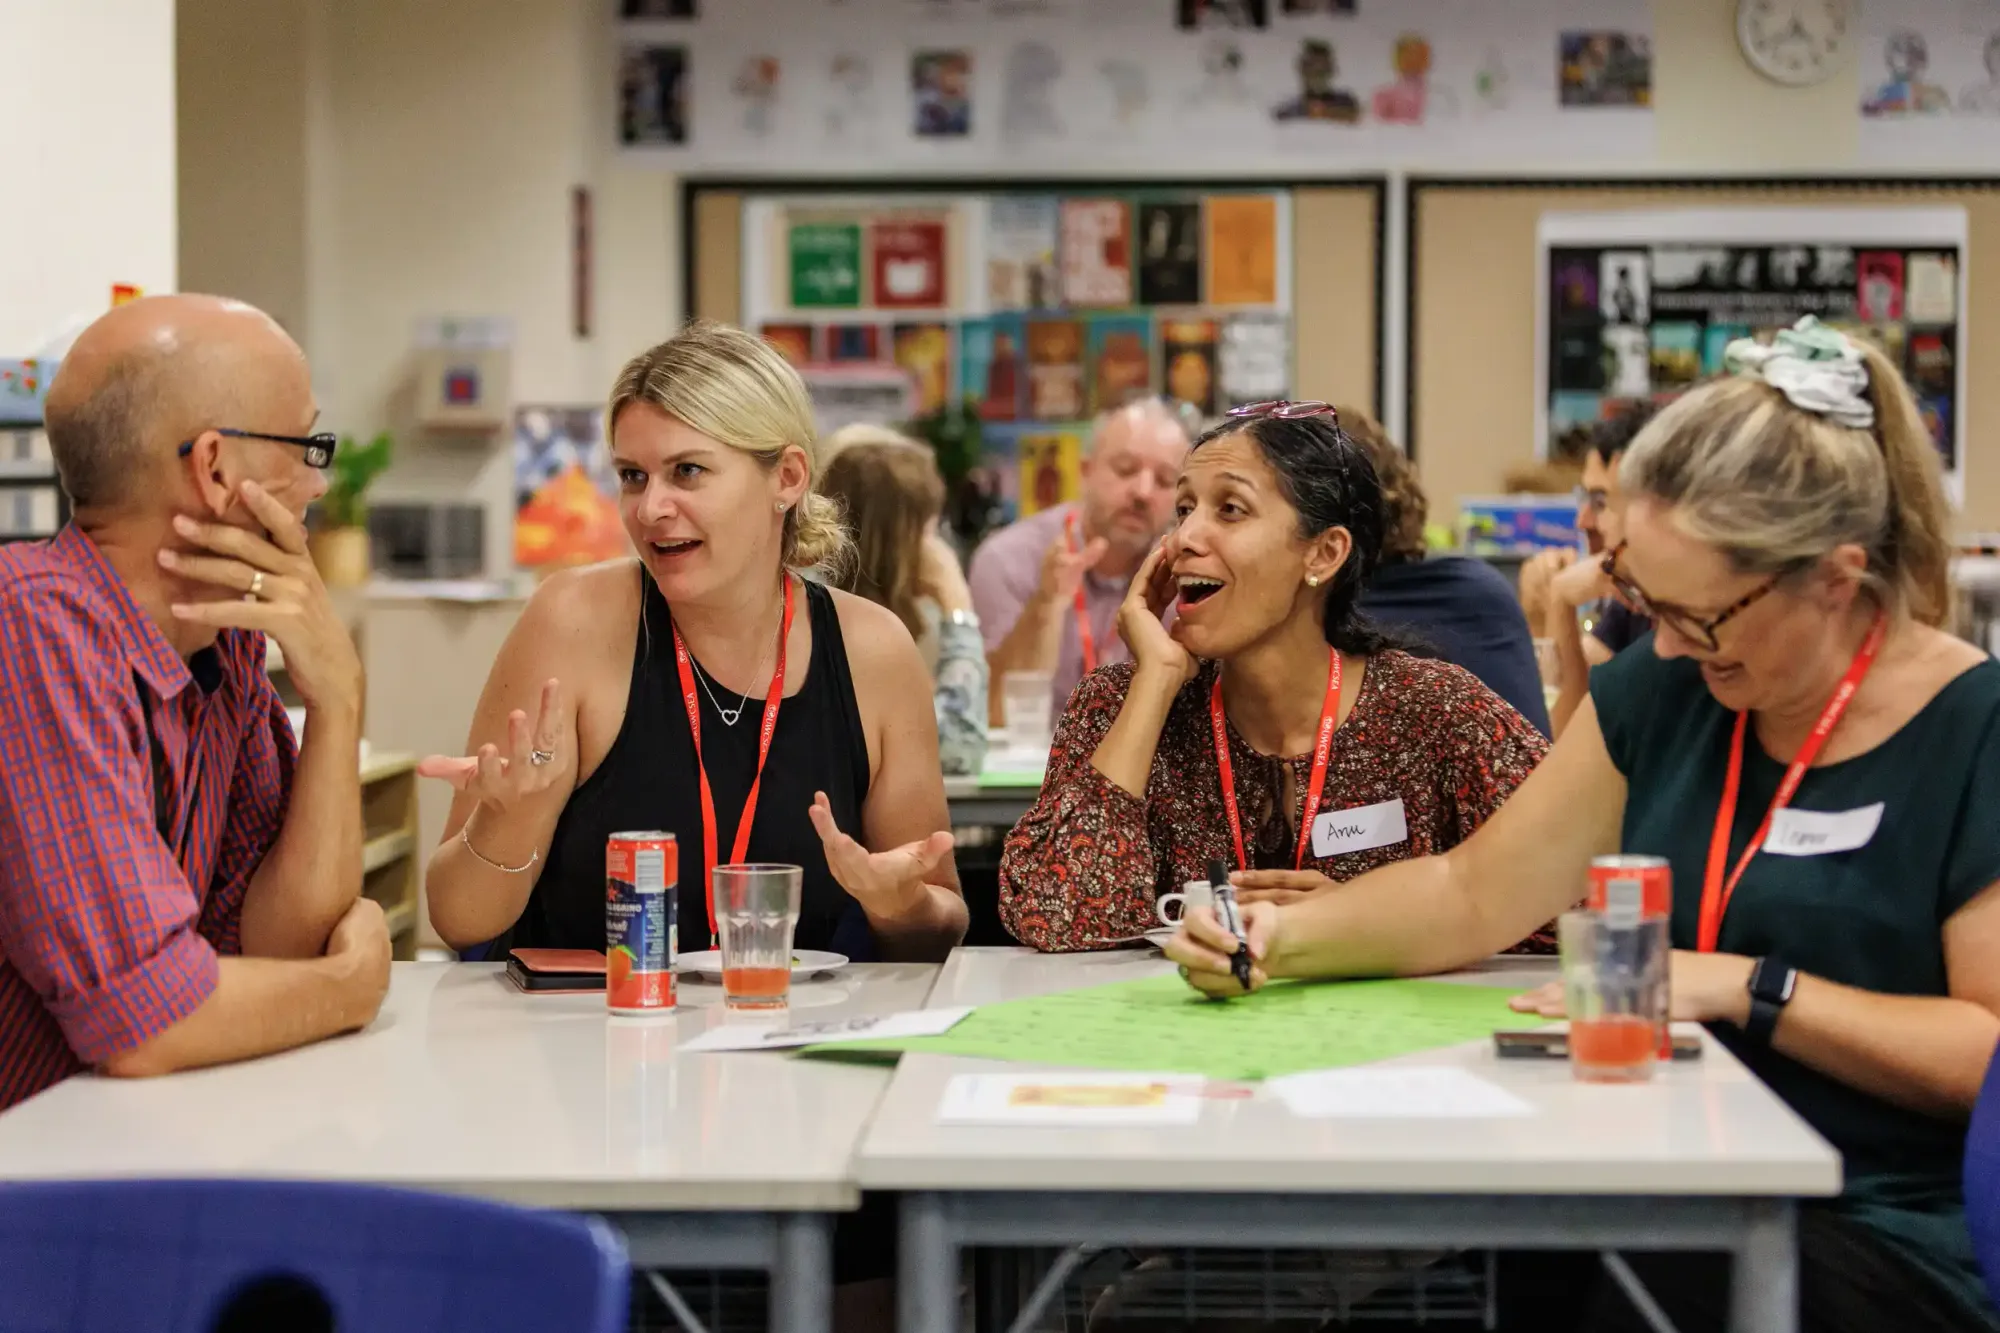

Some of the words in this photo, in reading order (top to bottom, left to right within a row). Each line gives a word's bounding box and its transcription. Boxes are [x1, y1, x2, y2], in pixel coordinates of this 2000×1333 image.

[1331, 657, 1341, 690] UWCSEA
[687, 692, 698, 731] UWCSEA
[1214, 711, 1225, 748] UWCSEA
[762, 717, 774, 753] UWCSEA
[1316, 730, 1332, 767] UWCSEA
[1225, 792, 1237, 832] UWCSEA
[1301, 808, 1317, 845] UWCSEA
[1327, 822, 1366, 841] Anu
